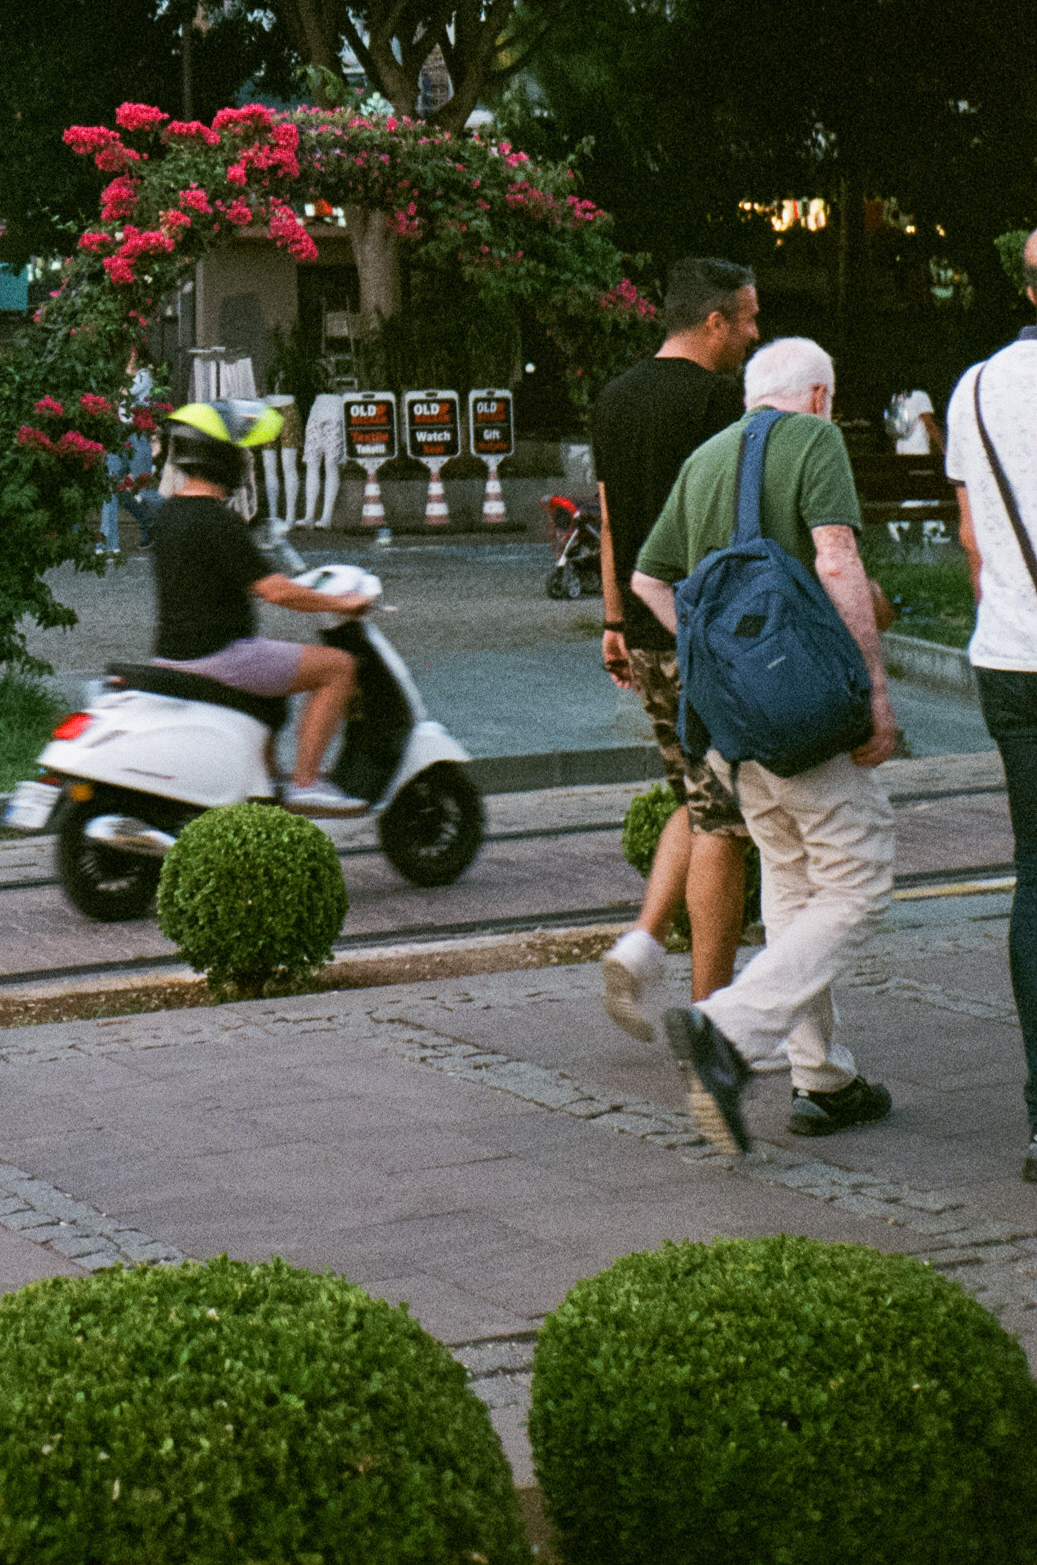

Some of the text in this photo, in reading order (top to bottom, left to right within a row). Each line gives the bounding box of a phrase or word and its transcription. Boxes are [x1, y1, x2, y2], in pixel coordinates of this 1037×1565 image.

[350, 405, 377, 417] OLD
[413, 403, 440, 416] OLD
[476, 401, 497, 414] OLD
[415, 431, 451, 442] Watch
